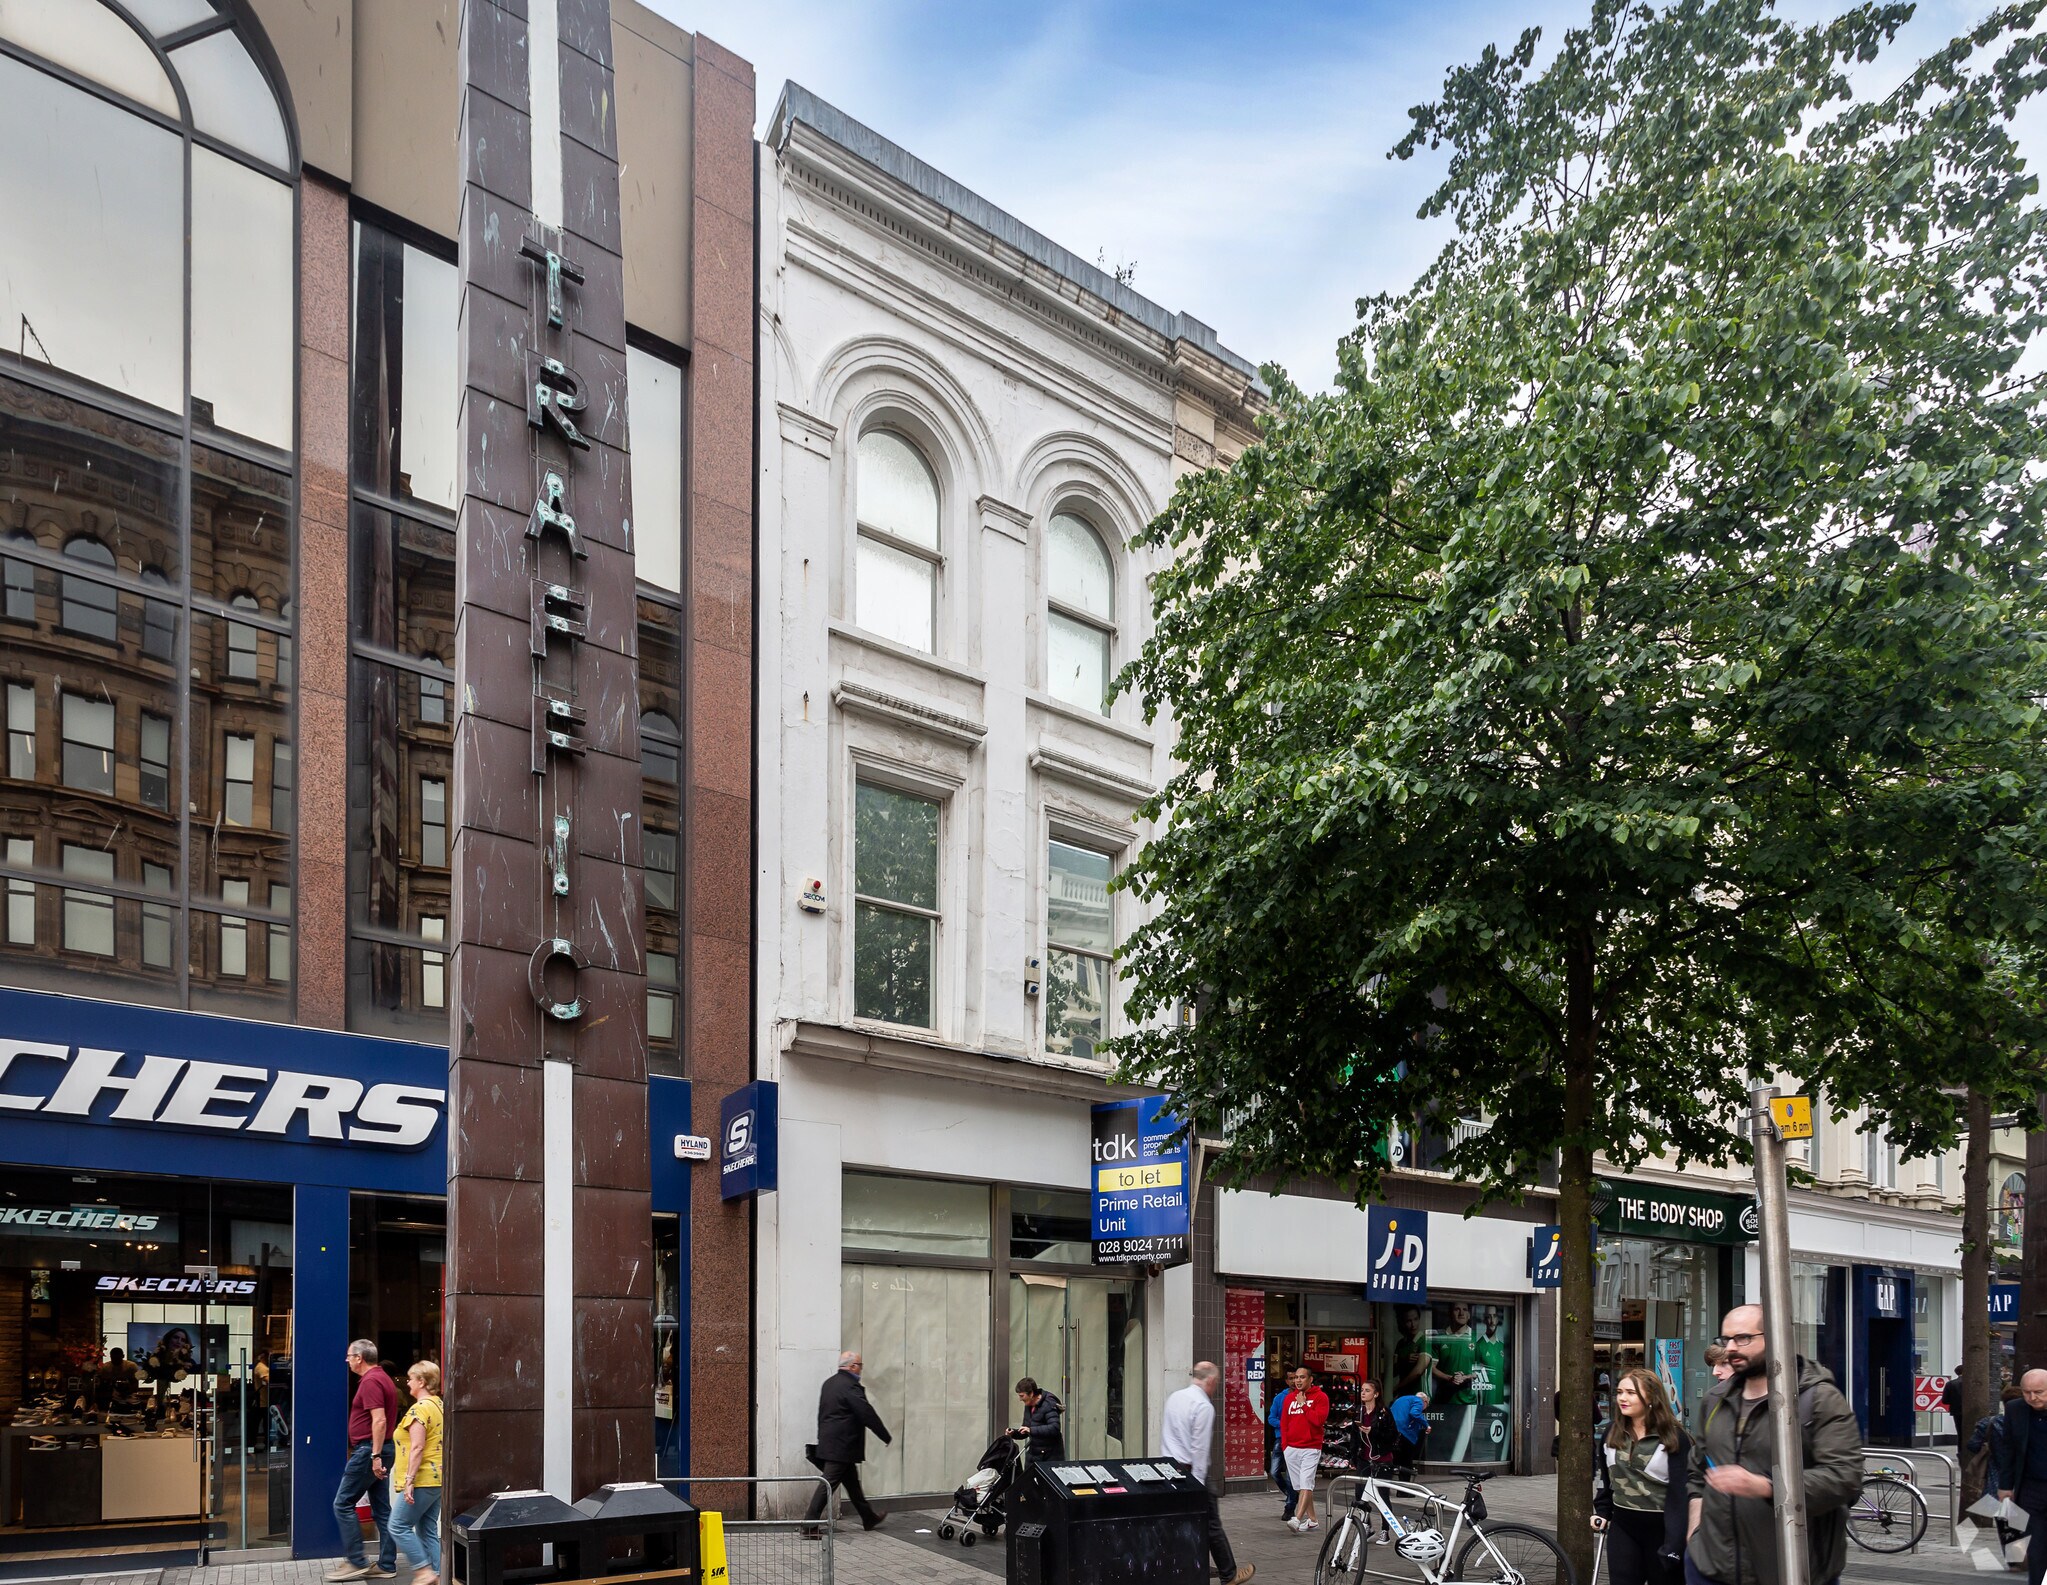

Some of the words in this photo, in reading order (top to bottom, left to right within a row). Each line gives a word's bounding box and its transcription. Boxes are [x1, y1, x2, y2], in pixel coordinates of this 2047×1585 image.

[517, 233, 592, 1020] TRAFFIC
[803, 892, 826, 903] SECOM
[1780, 1124, 1791, 1133] am
[1792, 1121, 1798, 1132] 6
[1798, 1122, 1810, 1134] pm
[680, 1138, 708, 1150] HYLAND
[1092, 1133, 1137, 1162] tdk
[1390, 1144, 1402, 1156] JD
[722, 1154, 755, 1175] SKECHERS
[1118, 1173, 1135, 1187] to
[1140, 1169, 1161, 1185] let
[1099, 1197, 1139, 1213] Prime
[1142, 1192, 1183, 1209] Retail
[1618, 1196, 1646, 1221] THE
[1650, 1201, 1687, 1225] BODY
[1688, 1206, 1725, 1229] SHOP
[1099, 1218, 1127, 1233] Unit
[1098, 1241, 1121, 1254] 028
[1123, 1239, 1153, 1253] 9024
[1156, 1237, 1184, 1250] 7111
[1098, 1251, 1172, 1263] www.tdkproperty.com
[1537, 1268, 1560, 1279] SPO
[1372, 1273, 1420, 1291] SPORTS
[1878, 1284, 1895, 1311] GAP
[1344, 1337, 1365, 1346] SALE
[1304, 1352, 1324, 1361] SALE
[1472, 1383, 1493, 1391] adidas
[1492, 1425, 1503, 1437] JD
[710, 1566, 726, 1577] SIR
